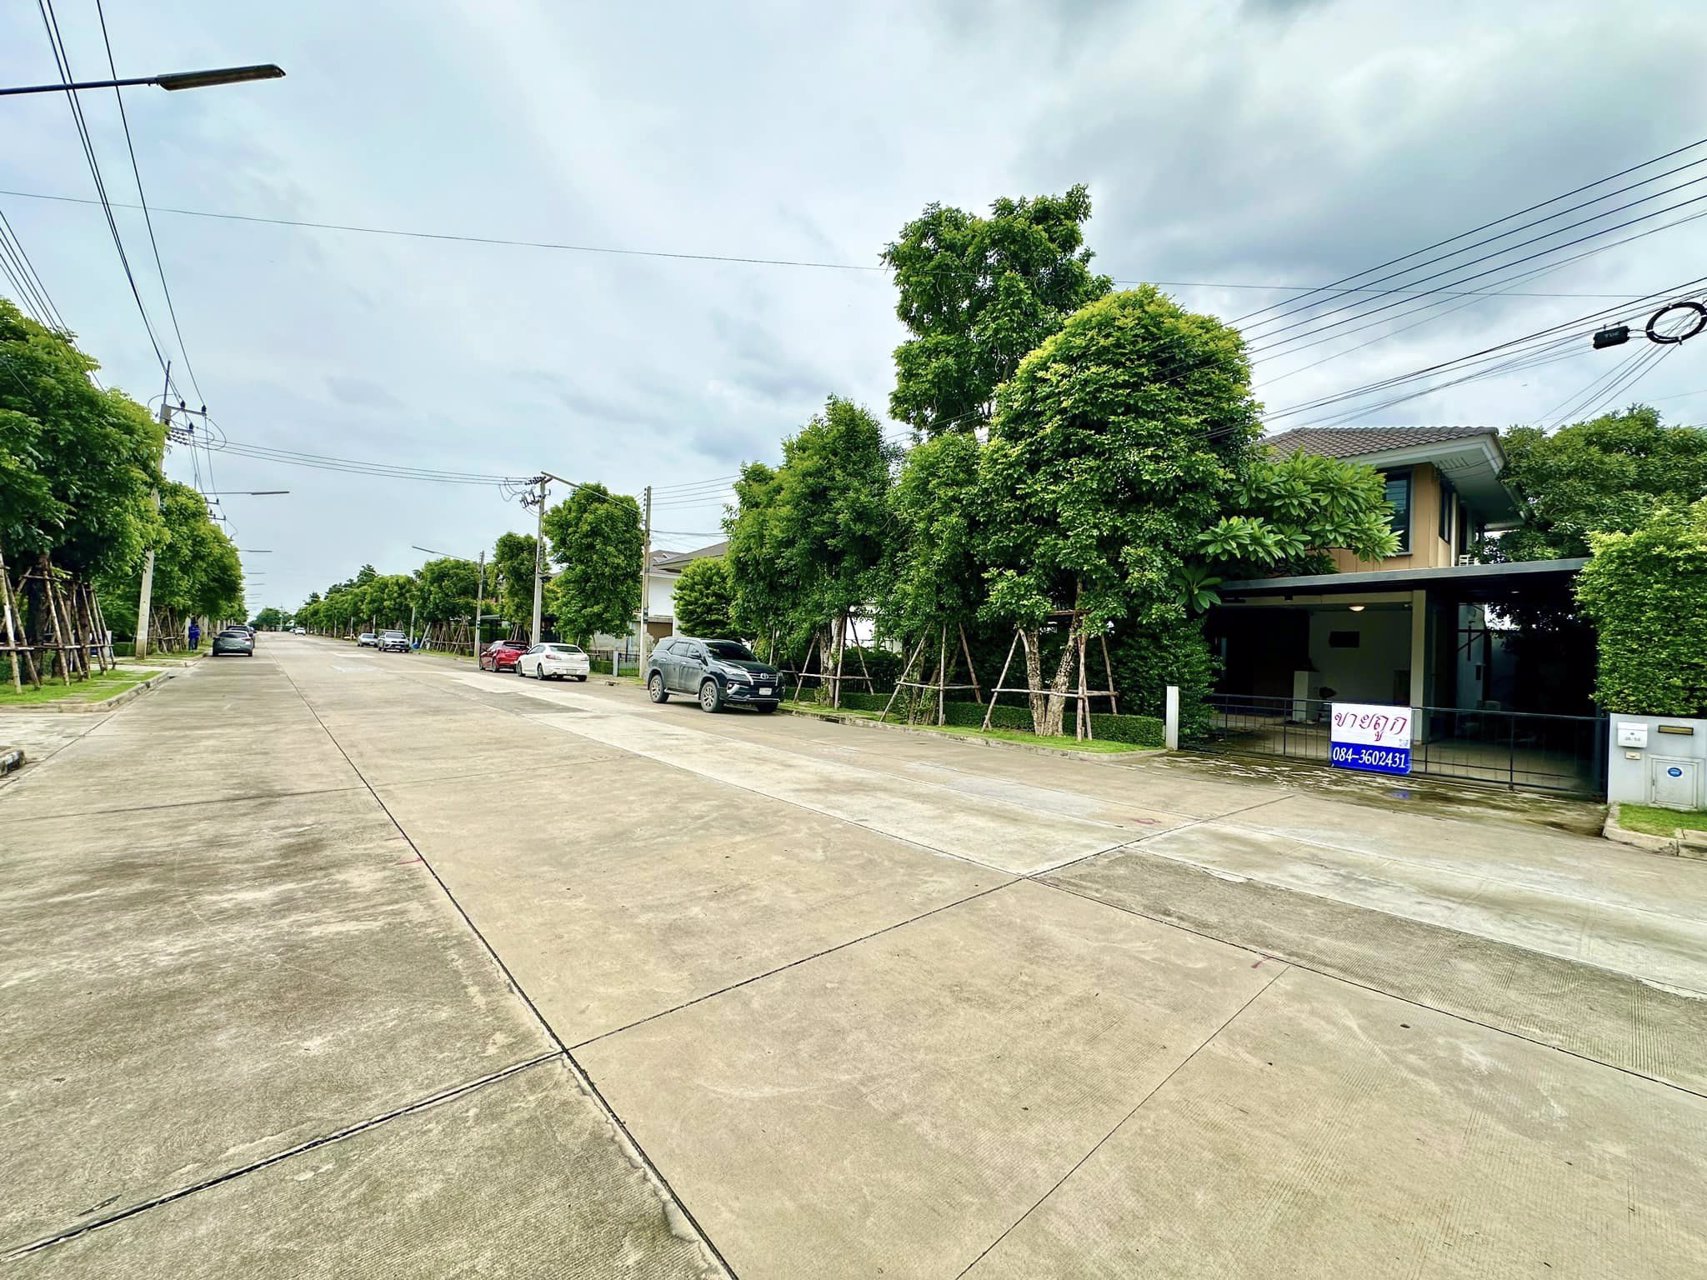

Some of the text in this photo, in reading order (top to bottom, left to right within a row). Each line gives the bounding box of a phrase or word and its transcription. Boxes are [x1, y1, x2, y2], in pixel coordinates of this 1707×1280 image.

[1334, 712, 1407, 741] ขายถูก
[1333, 747, 1406, 768] 084-3602431
